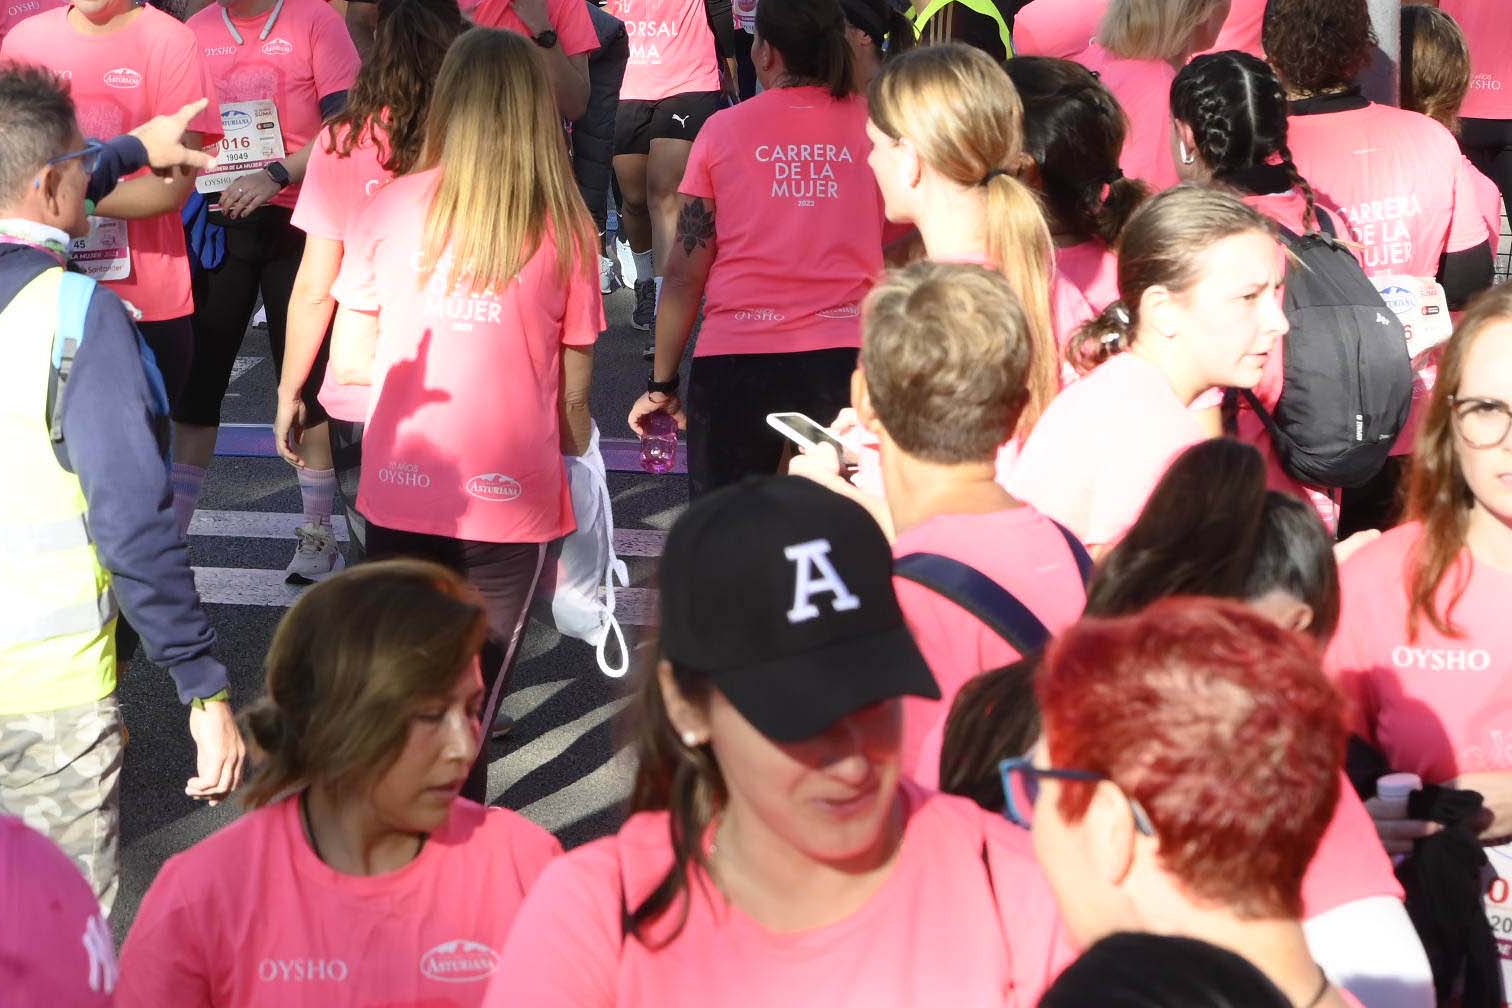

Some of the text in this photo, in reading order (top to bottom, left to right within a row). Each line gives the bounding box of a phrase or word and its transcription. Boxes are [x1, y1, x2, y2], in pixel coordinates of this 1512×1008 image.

[627, 21, 678, 37] ORSAL
[630, 44, 660, 59] MA
[222, 137, 250, 150] 016
[226, 152, 248, 162] 19049
[755, 144, 852, 162] CARRERA
[775, 162, 834, 179] DE LA
[771, 180, 838, 198] MUJER
[1381, 220, 1412, 241] LA
[1366, 240, 1412, 267] UJER
[378, 468, 430, 487] OYSHO
[470, 482, 518, 495] ASTURIANA
[784, 539, 860, 622] A
[1391, 645, 1491, 671] OYSHO
[258, 959, 348, 982] OYSHO
